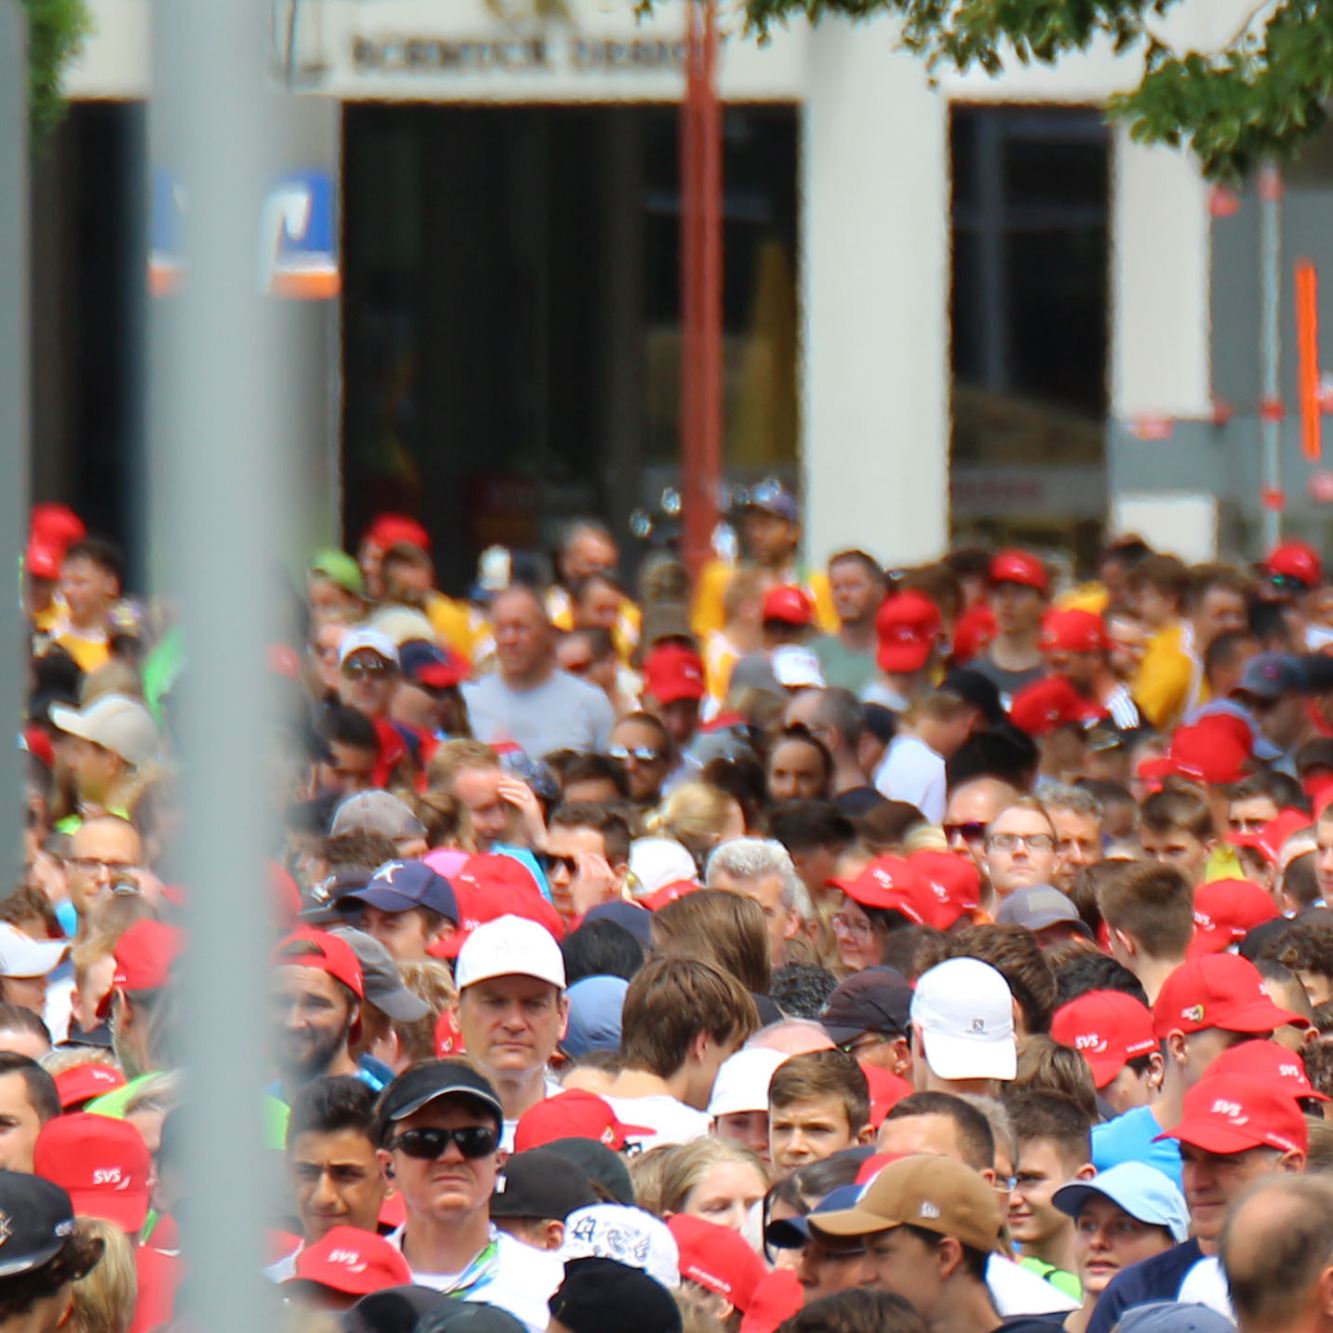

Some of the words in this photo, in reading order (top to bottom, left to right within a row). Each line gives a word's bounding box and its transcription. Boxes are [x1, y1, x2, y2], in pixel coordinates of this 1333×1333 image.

[1075, 1033, 1099, 1050] SVS
[1212, 1098, 1243, 1118] SVS
[93, 1167, 122, 1185] SVS
[329, 1249, 360, 1266] SVS
